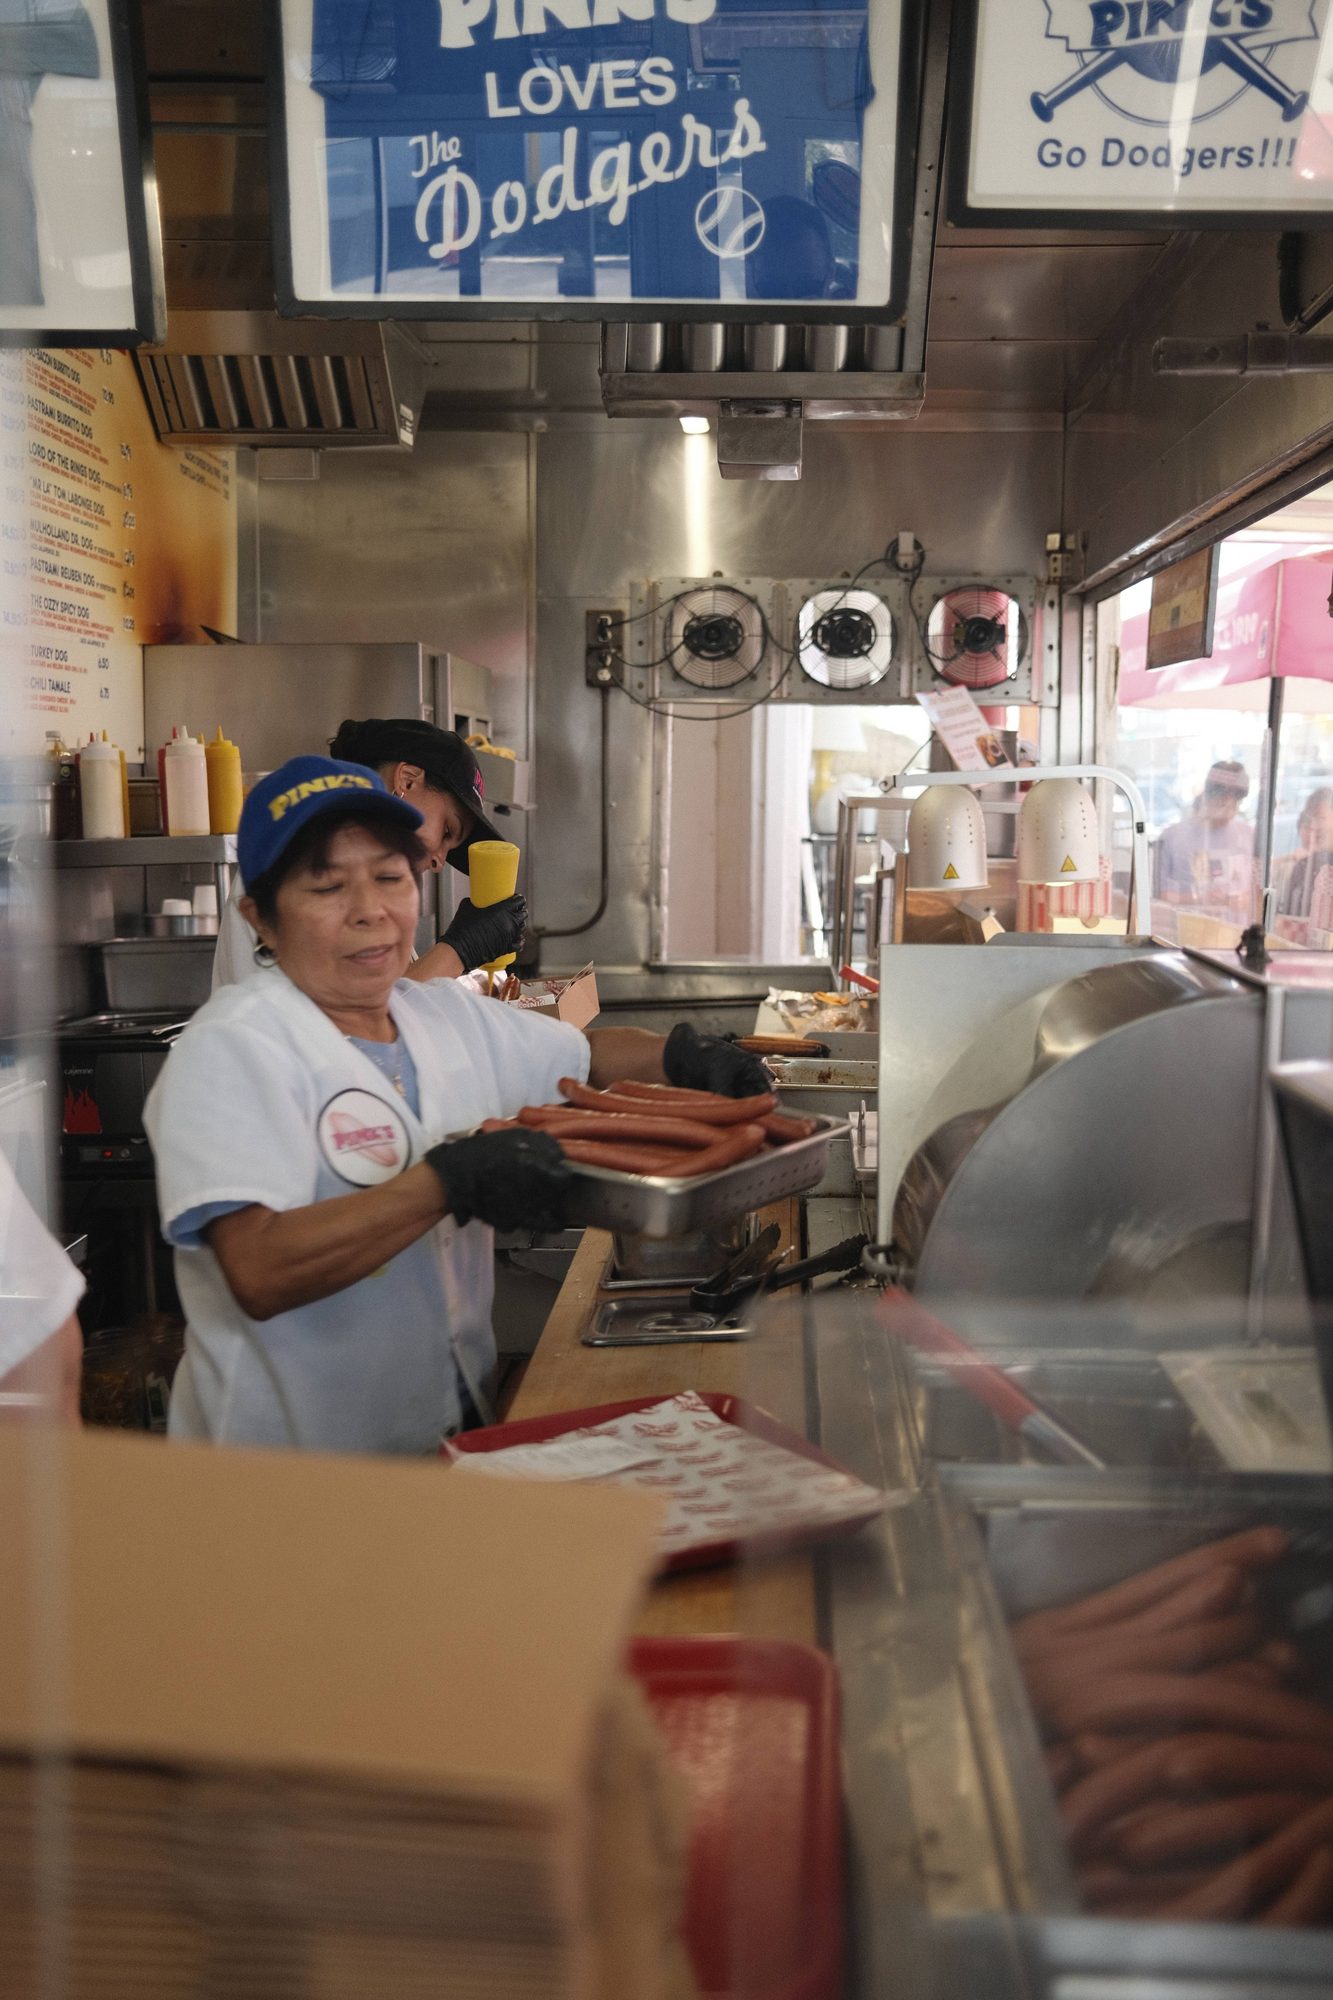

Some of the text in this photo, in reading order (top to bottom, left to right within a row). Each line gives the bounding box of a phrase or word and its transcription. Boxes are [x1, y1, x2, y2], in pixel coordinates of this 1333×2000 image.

[486, 56, 677, 118] LOVES
[408, 131, 462, 178] The
[1037, 138, 1086, 168] Go
[414, 98, 767, 260] Dodgers
[27, 394, 93, 439] PASTRAMI BURRITO DOG
[29, 440, 46, 459] LORD
[47, 449, 56, 463] OF
[57, 453, 69, 470] THE
[70, 459, 87, 479] RINGS
[88, 468, 101, 484] DOG
[53, 485, 66, 500] TOM
[94, 501, 105, 516] DOG
[30, 518, 70, 543] MULHOLLAND
[81, 536, 94, 551] DOG
[30, 558, 59, 576] PASTRAMI
[60, 564, 82, 583] REUBEN
[83, 572, 96, 587] DOG
[31, 593, 43, 608] THE
[44, 597, 60, 612] OZZY
[60, 601, 76, 617] SPICY
[77, 605, 90, 619] DOG
[31, 645, 54, 660] TURKEY
[54, 650, 68, 662] DOG
[30, 678, 47, 692] CHILI
[47, 679, 71, 694] TAMALE
